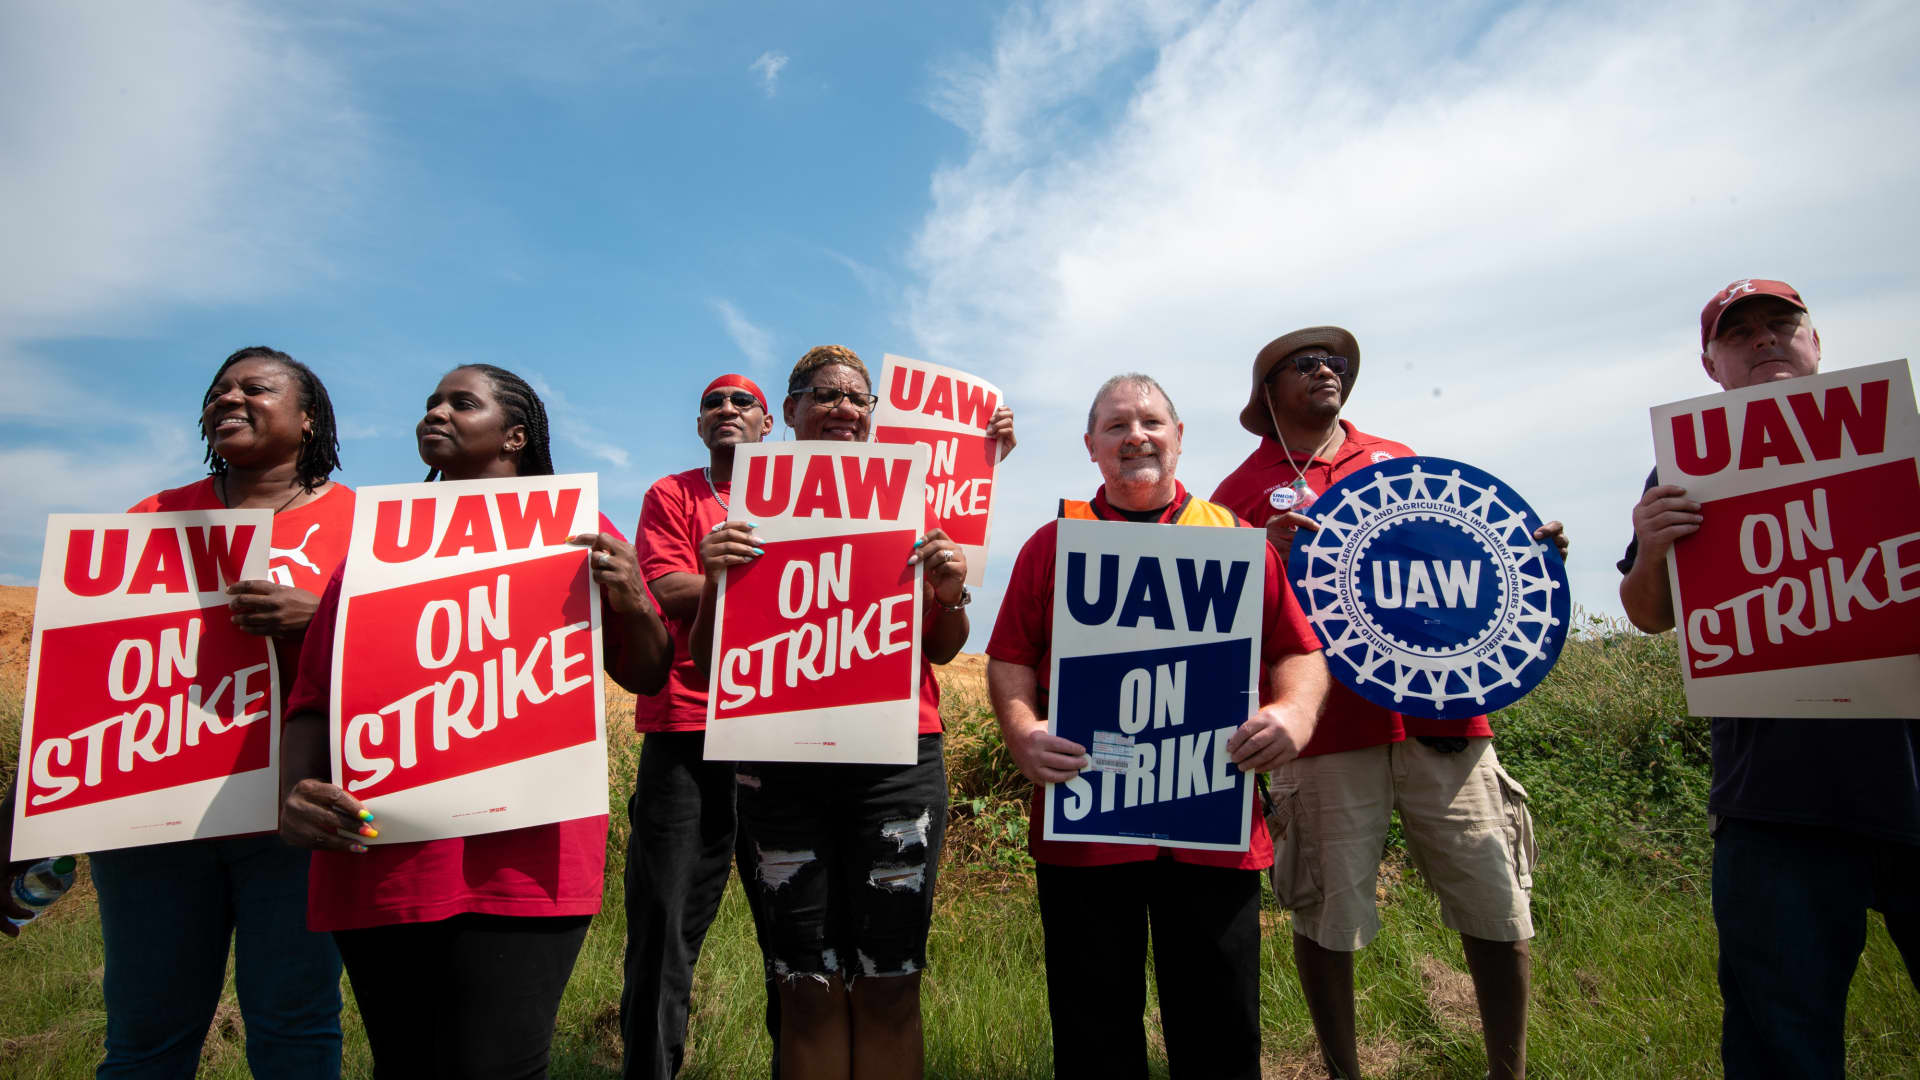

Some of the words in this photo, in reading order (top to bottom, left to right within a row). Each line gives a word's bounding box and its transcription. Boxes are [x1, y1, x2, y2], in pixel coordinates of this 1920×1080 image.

[889, 366, 998, 430] UAW
[1671, 379, 1889, 477] UAW
[745, 454, 912, 521] UAW
[1373, 508, 1393, 522] AND
[1397, 502, 1468, 520] AGRICULTURAL
[64, 525, 256, 597] UAW
[372, 488, 581, 563] UAW
[1341, 520, 1372, 564] AEROSPACE
[1469, 516, 1511, 561] IMPLEMENT
[1739, 488, 1834, 575] ON
[778, 543, 853, 619] ON
[1066, 552, 1250, 633] UAW
[1372, 560, 1481, 609] UAW
[1508, 564, 1520, 609] WORKERS
[1687, 531, 1920, 670] STRIKE
[416, 574, 510, 669] ON
[719, 593, 912, 711] STRIKE
[1361, 628, 1393, 655] UNITED
[1473, 627, 1508, 658] AMERICA
[1507, 612, 1515, 625] OF
[108, 618, 201, 701] ON
[31, 662, 269, 806] STRIKE
[344, 621, 592, 792] STRIKE
[1119, 660, 1187, 735] ON
